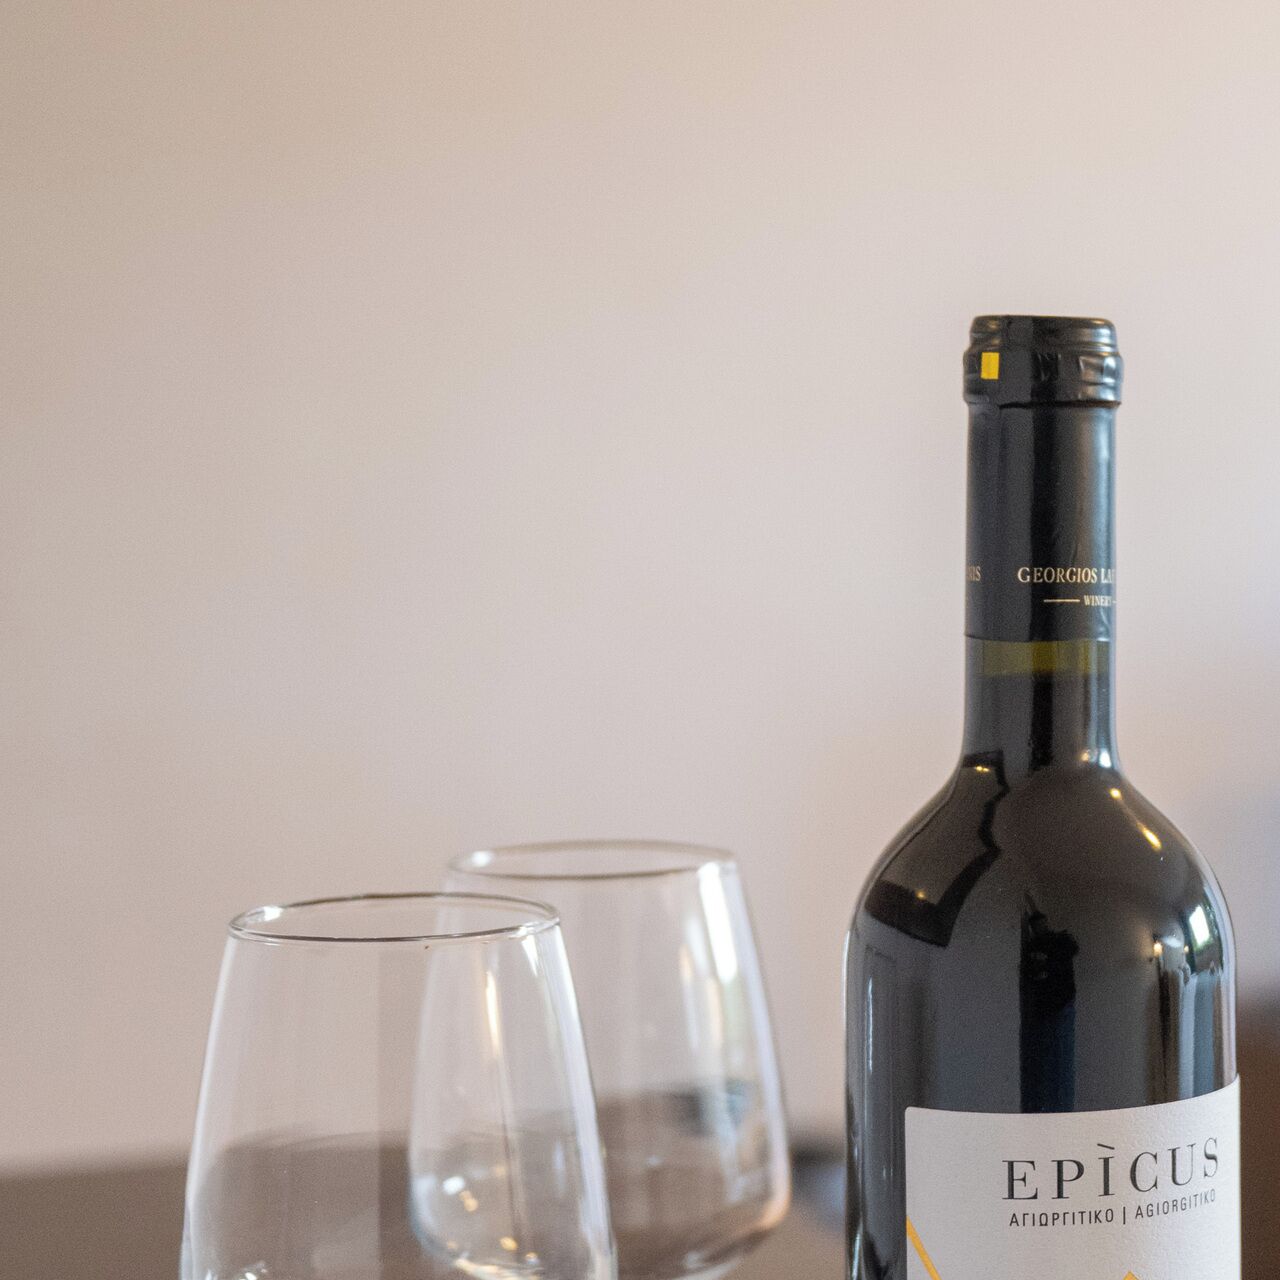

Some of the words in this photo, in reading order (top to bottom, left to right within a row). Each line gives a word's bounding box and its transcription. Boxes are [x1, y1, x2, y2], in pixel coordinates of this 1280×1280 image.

[1017, 566, 1098, 584] GEORGIOS
[1001, 1136, 1219, 1200] EPÌCUS
[1135, 1188, 1217, 1220] AGIORGITIKO
[1009, 1208, 1115, 1227] ΑΓΙΩΡΓΙΤΙΚΟ
